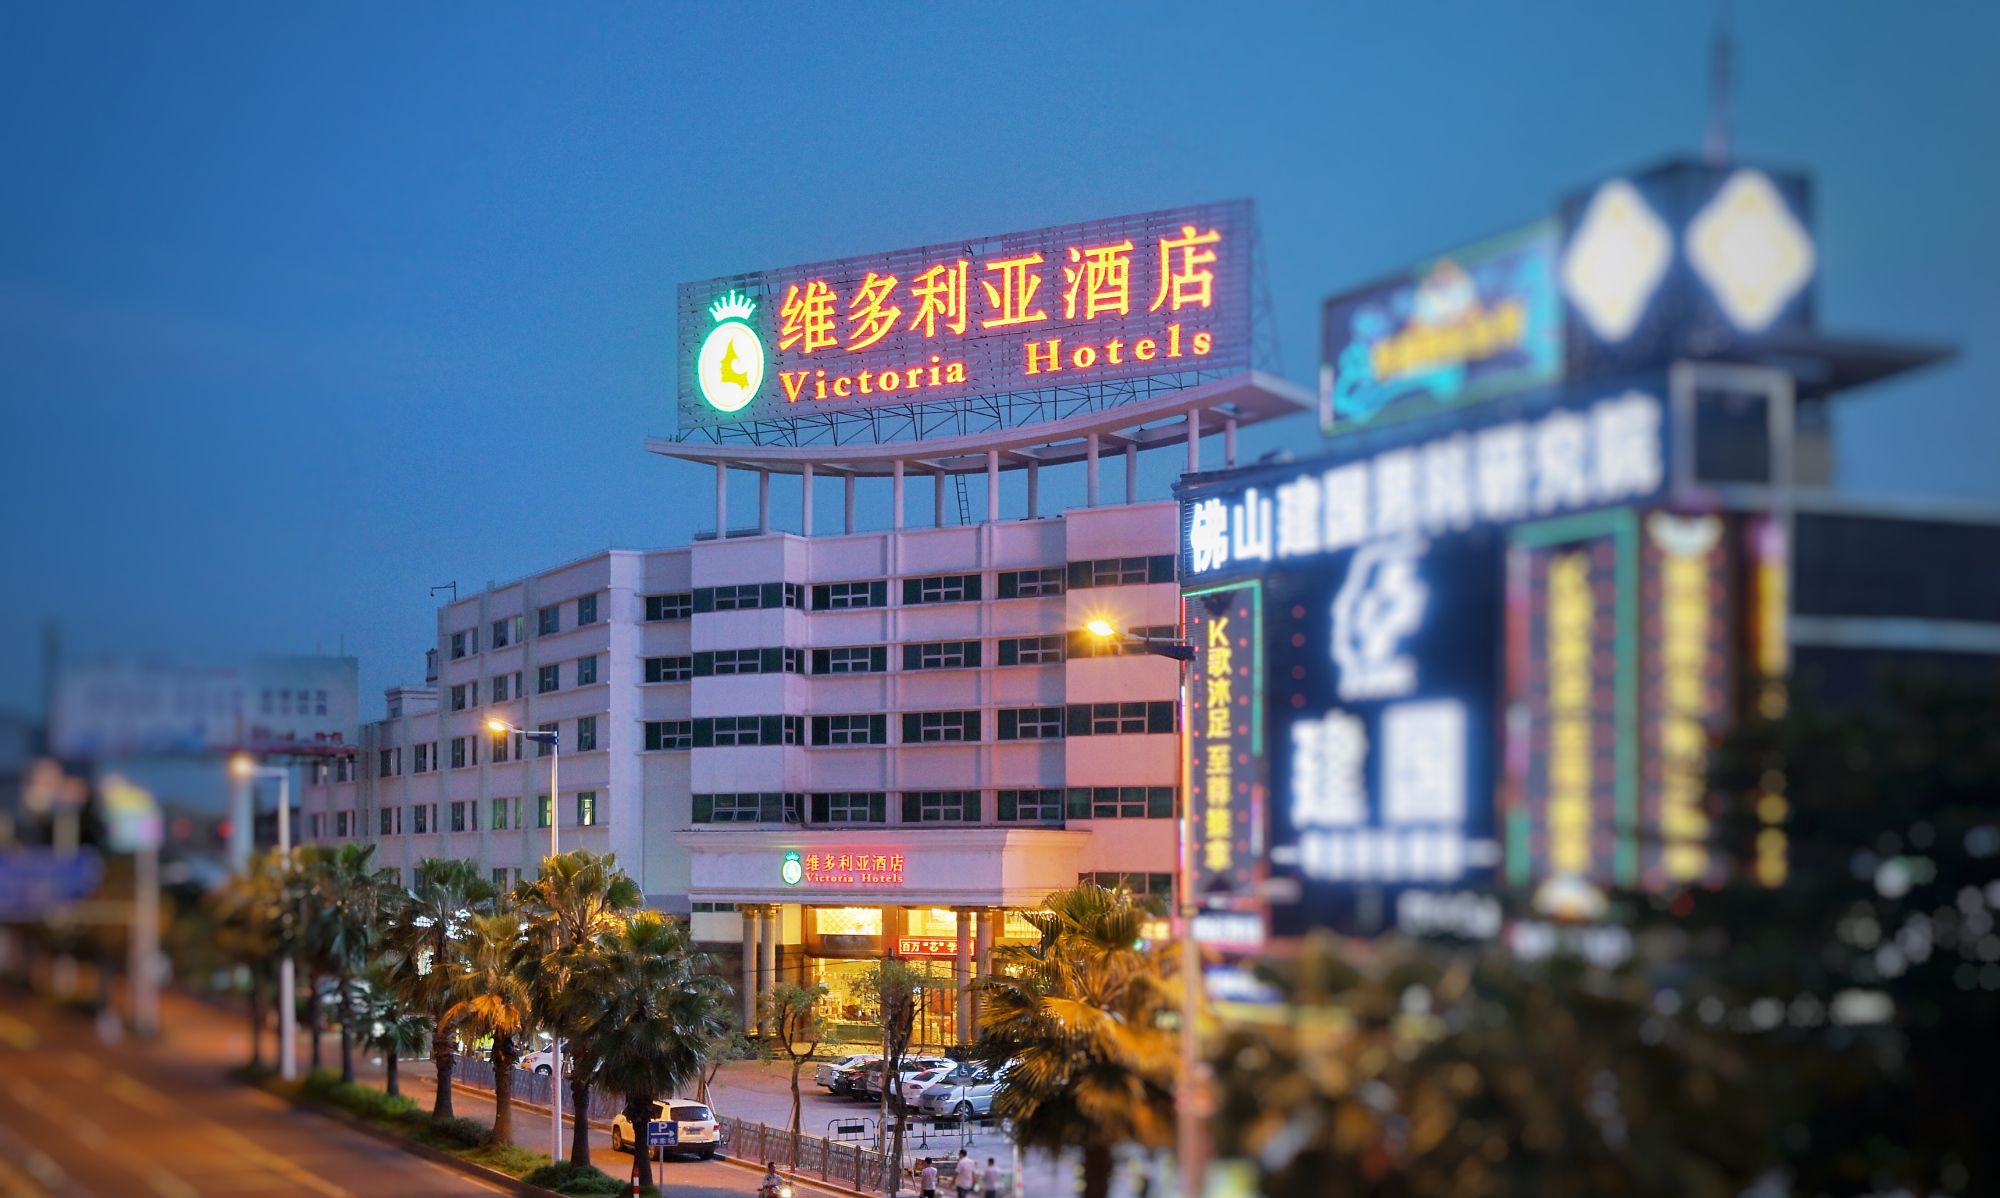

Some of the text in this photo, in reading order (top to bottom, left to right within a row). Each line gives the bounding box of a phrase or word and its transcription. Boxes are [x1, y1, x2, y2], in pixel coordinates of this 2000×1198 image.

[779, 225, 1221, 355] 维多利亚酒店
[779, 324, 1213, 403] Victoria Hotels
[805, 854, 904, 872] 维多利亚酒店
[805, 873, 903, 883] Victoria Hotels
[658, 1122, 668, 1132] P
